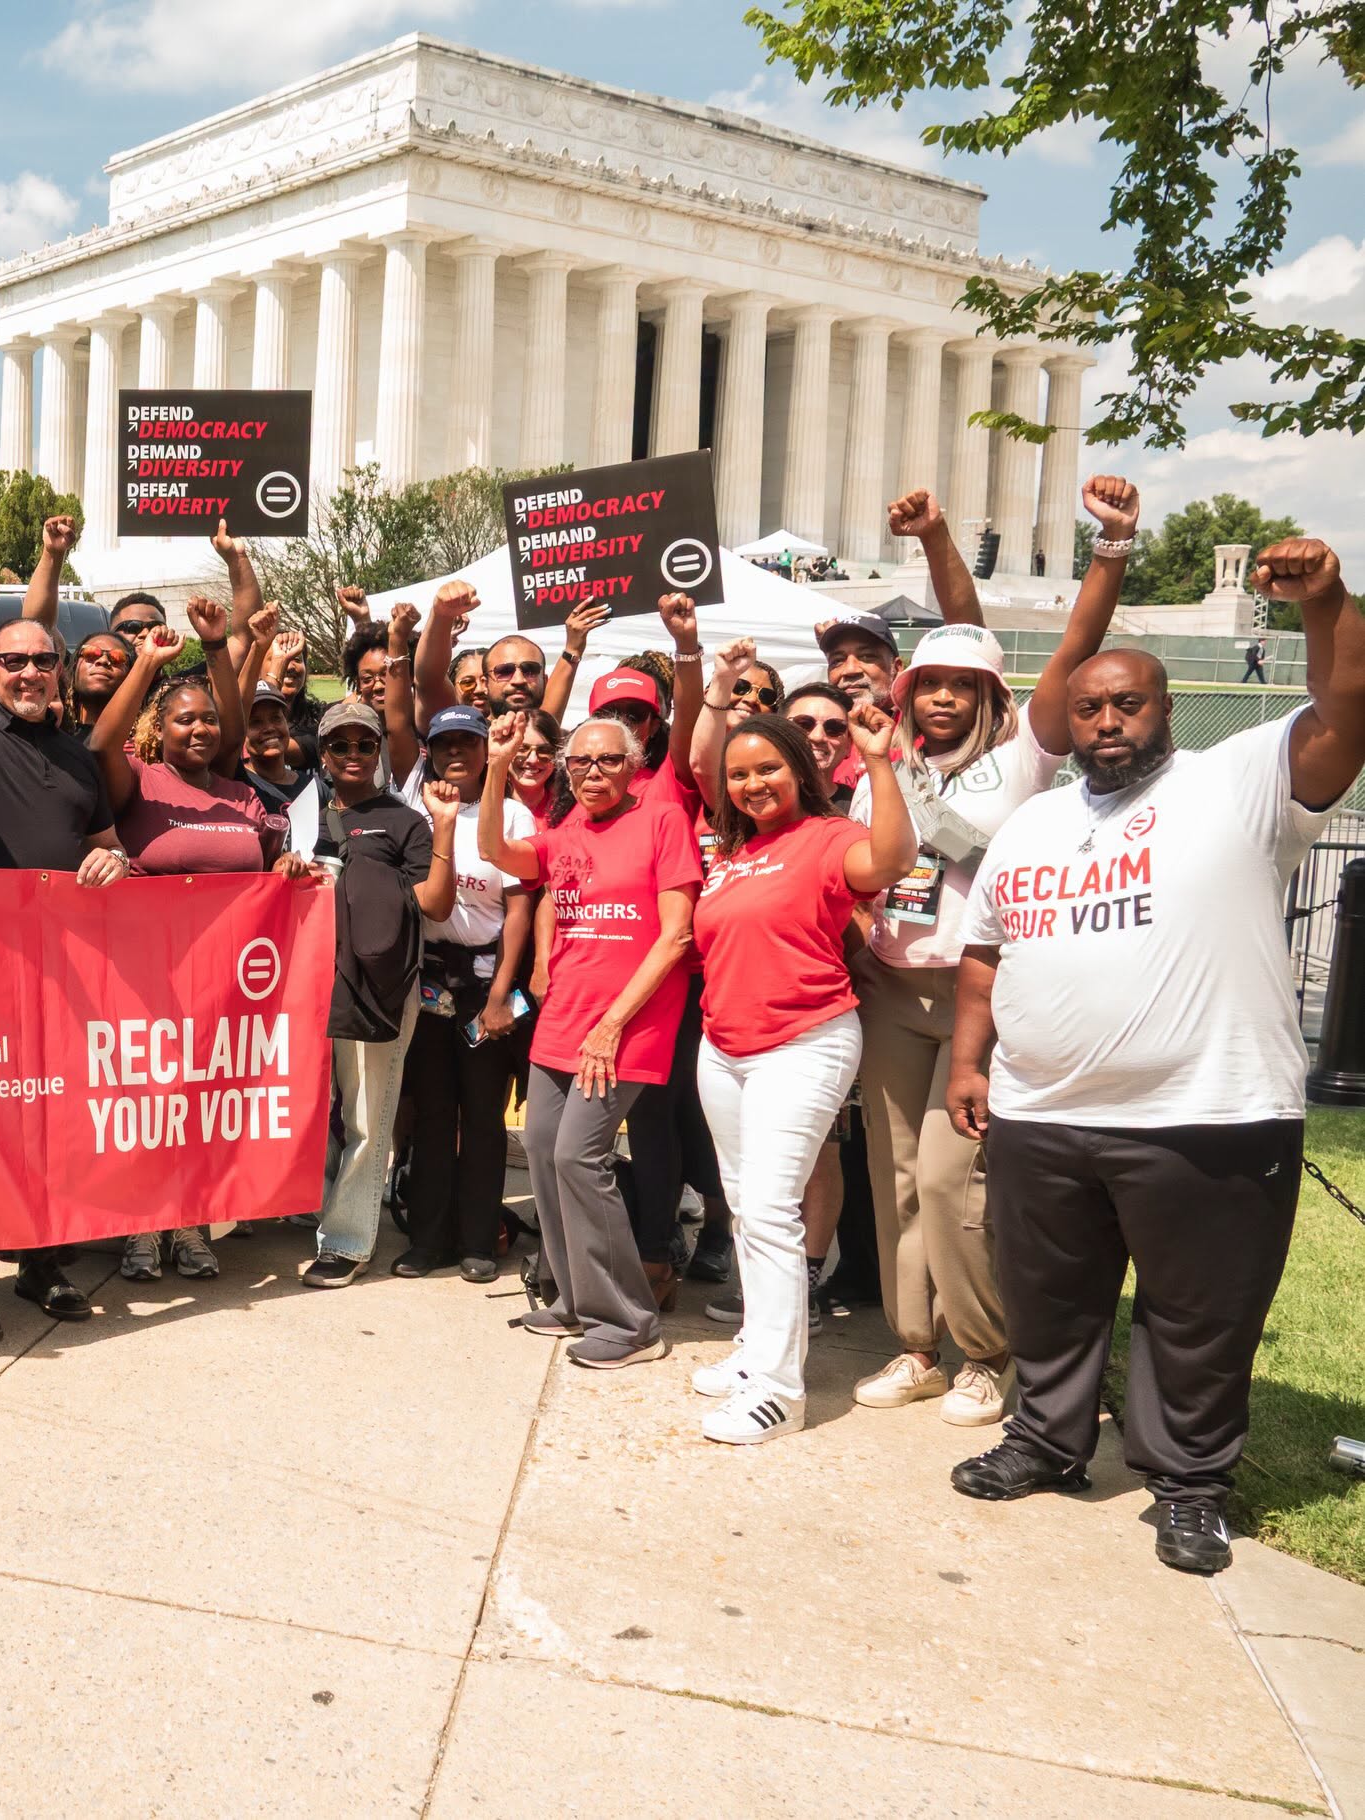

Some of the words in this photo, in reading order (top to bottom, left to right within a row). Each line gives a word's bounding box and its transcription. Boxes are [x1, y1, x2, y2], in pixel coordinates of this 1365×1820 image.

[128, 406, 194, 421] DEFEND
[138, 421, 268, 439] DEMOCRACY
[127, 445, 201, 459] DEMAND
[138, 460, 244, 477] DIVERSITY
[127, 483, 188, 498] DEFEAT
[514, 488, 583, 514] DEFEND
[137, 498, 230, 515] POVERTY
[527, 490, 666, 529] DEMOCRACY
[518, 526, 597, 551] DEMAND
[531, 534, 644, 568] DIVERSITY
[522, 566, 586, 590] DEFEAT
[536, 575, 633, 607] POVERTY
[168, 819, 216, 831] THURSDAY
[995, 847, 1151, 907] RECLAIM
[1001, 908, 1057, 941] YOUR
[1070, 893, 1153, 935] VOTE
[87, 1013, 289, 1088] RECLAIM
[87, 1093, 189, 1154] YOUR
[200, 1086, 292, 1144] VOTE
